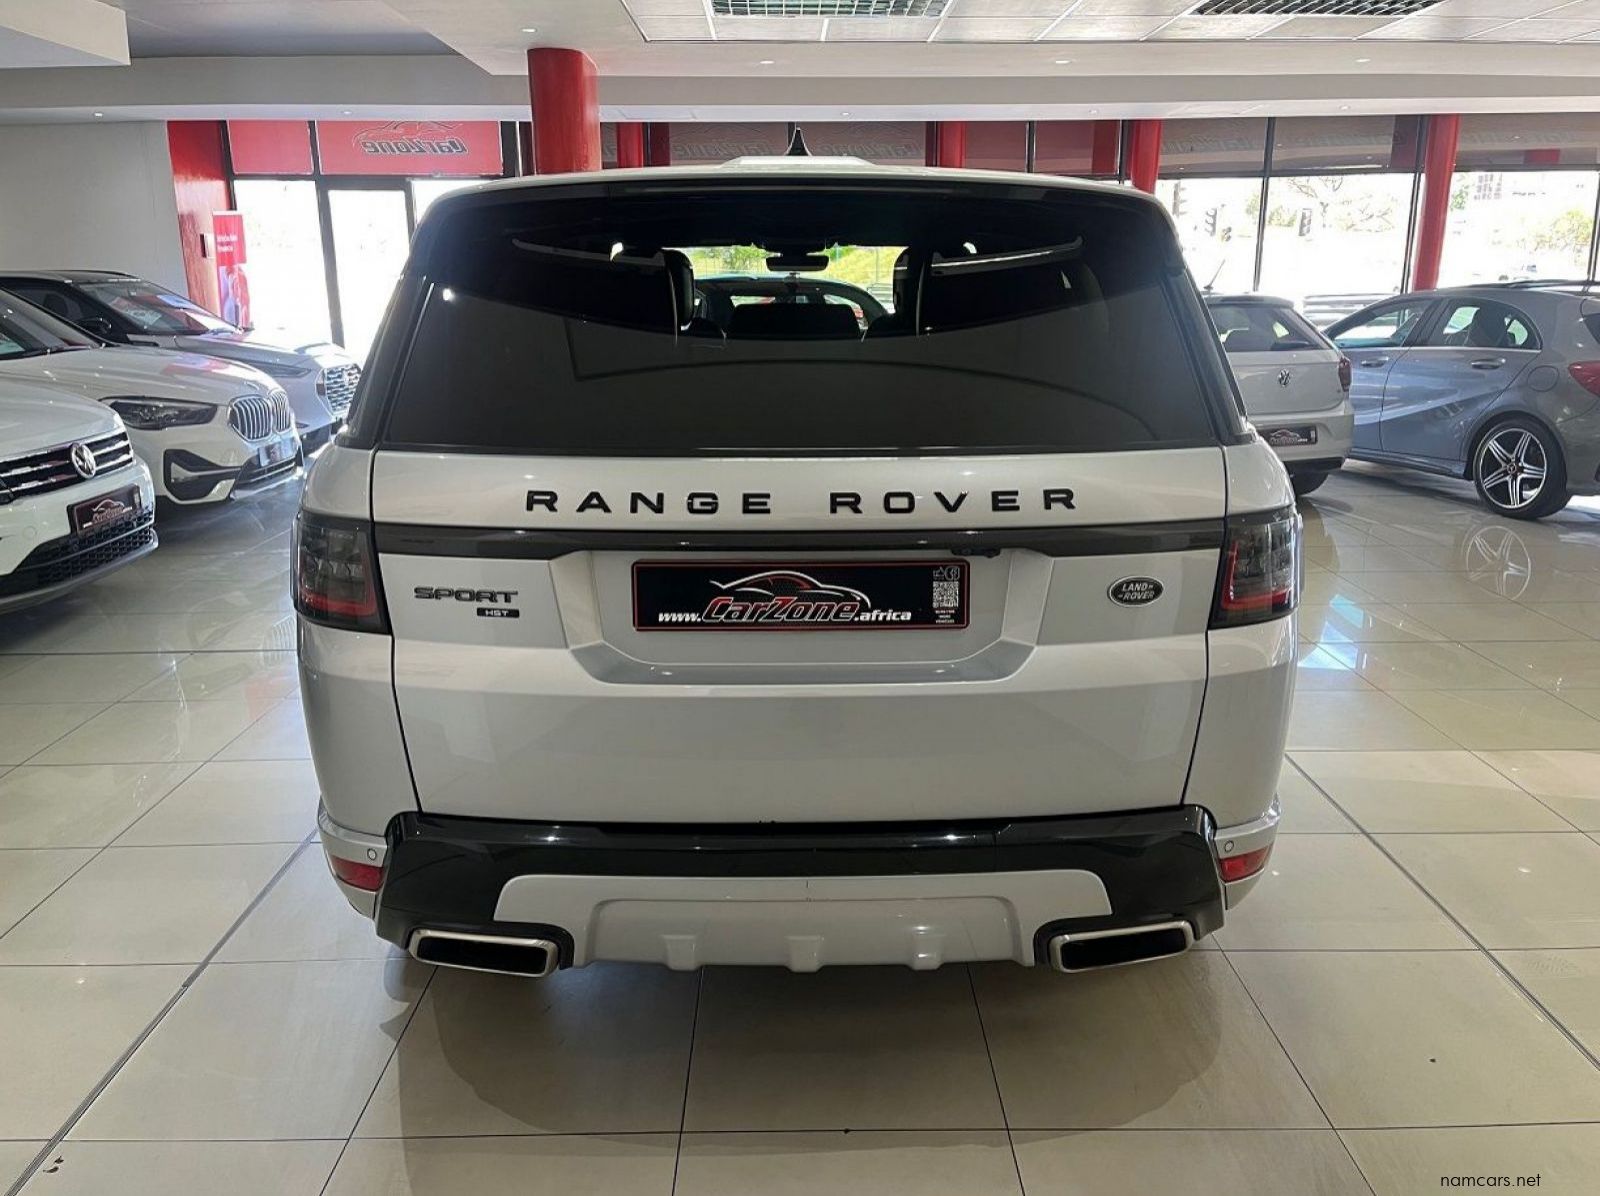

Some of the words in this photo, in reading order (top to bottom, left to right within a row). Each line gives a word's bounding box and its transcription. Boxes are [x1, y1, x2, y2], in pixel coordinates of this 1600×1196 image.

[525, 489, 772, 515] RANGE
[829, 487, 1077, 515] ROVER
[413, 586, 519, 604] SPORT
[484, 609, 509, 617] HST
